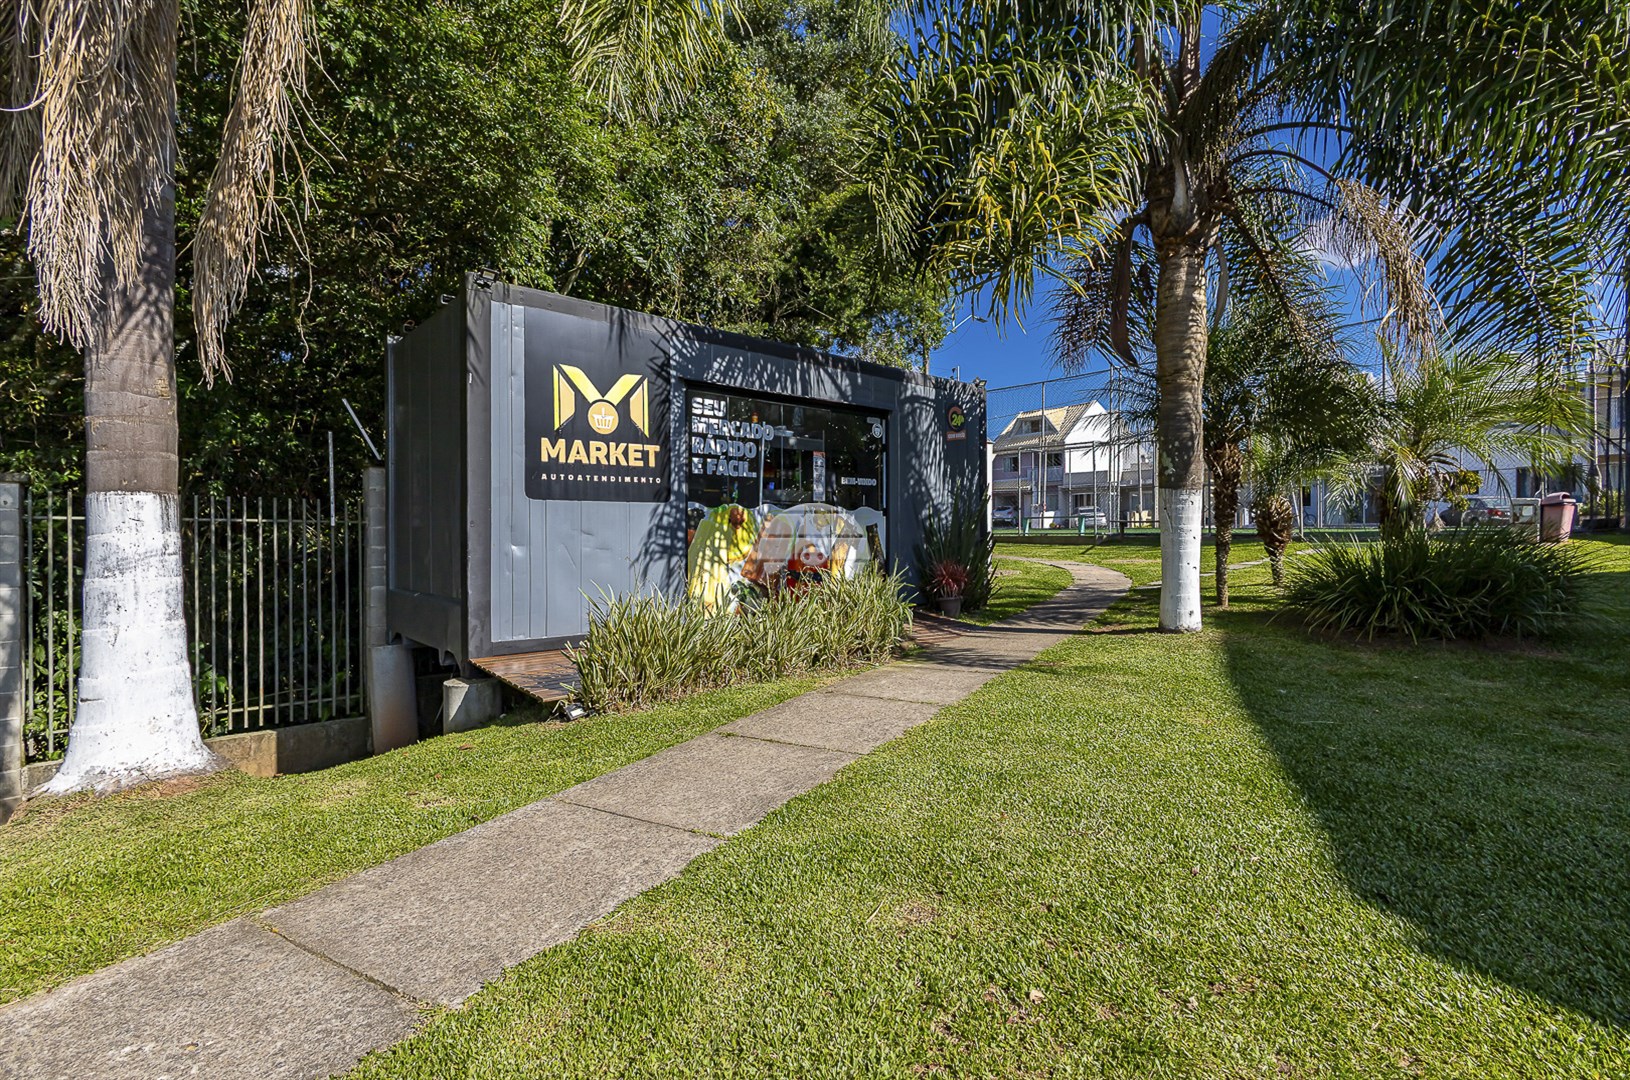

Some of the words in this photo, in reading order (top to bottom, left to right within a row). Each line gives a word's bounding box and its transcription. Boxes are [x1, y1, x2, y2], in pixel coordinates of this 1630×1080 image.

[691, 397, 727, 417] SEU
[691, 416, 775, 441] MERCADO
[540, 437, 660, 468] MARKET
[691, 434, 757, 459] RÁPIDO
[541, 473, 662, 484] AUTOATENDIMENTO
[691, 457, 704, 475] E
[706, 455, 757, 478] FÁCIL.
